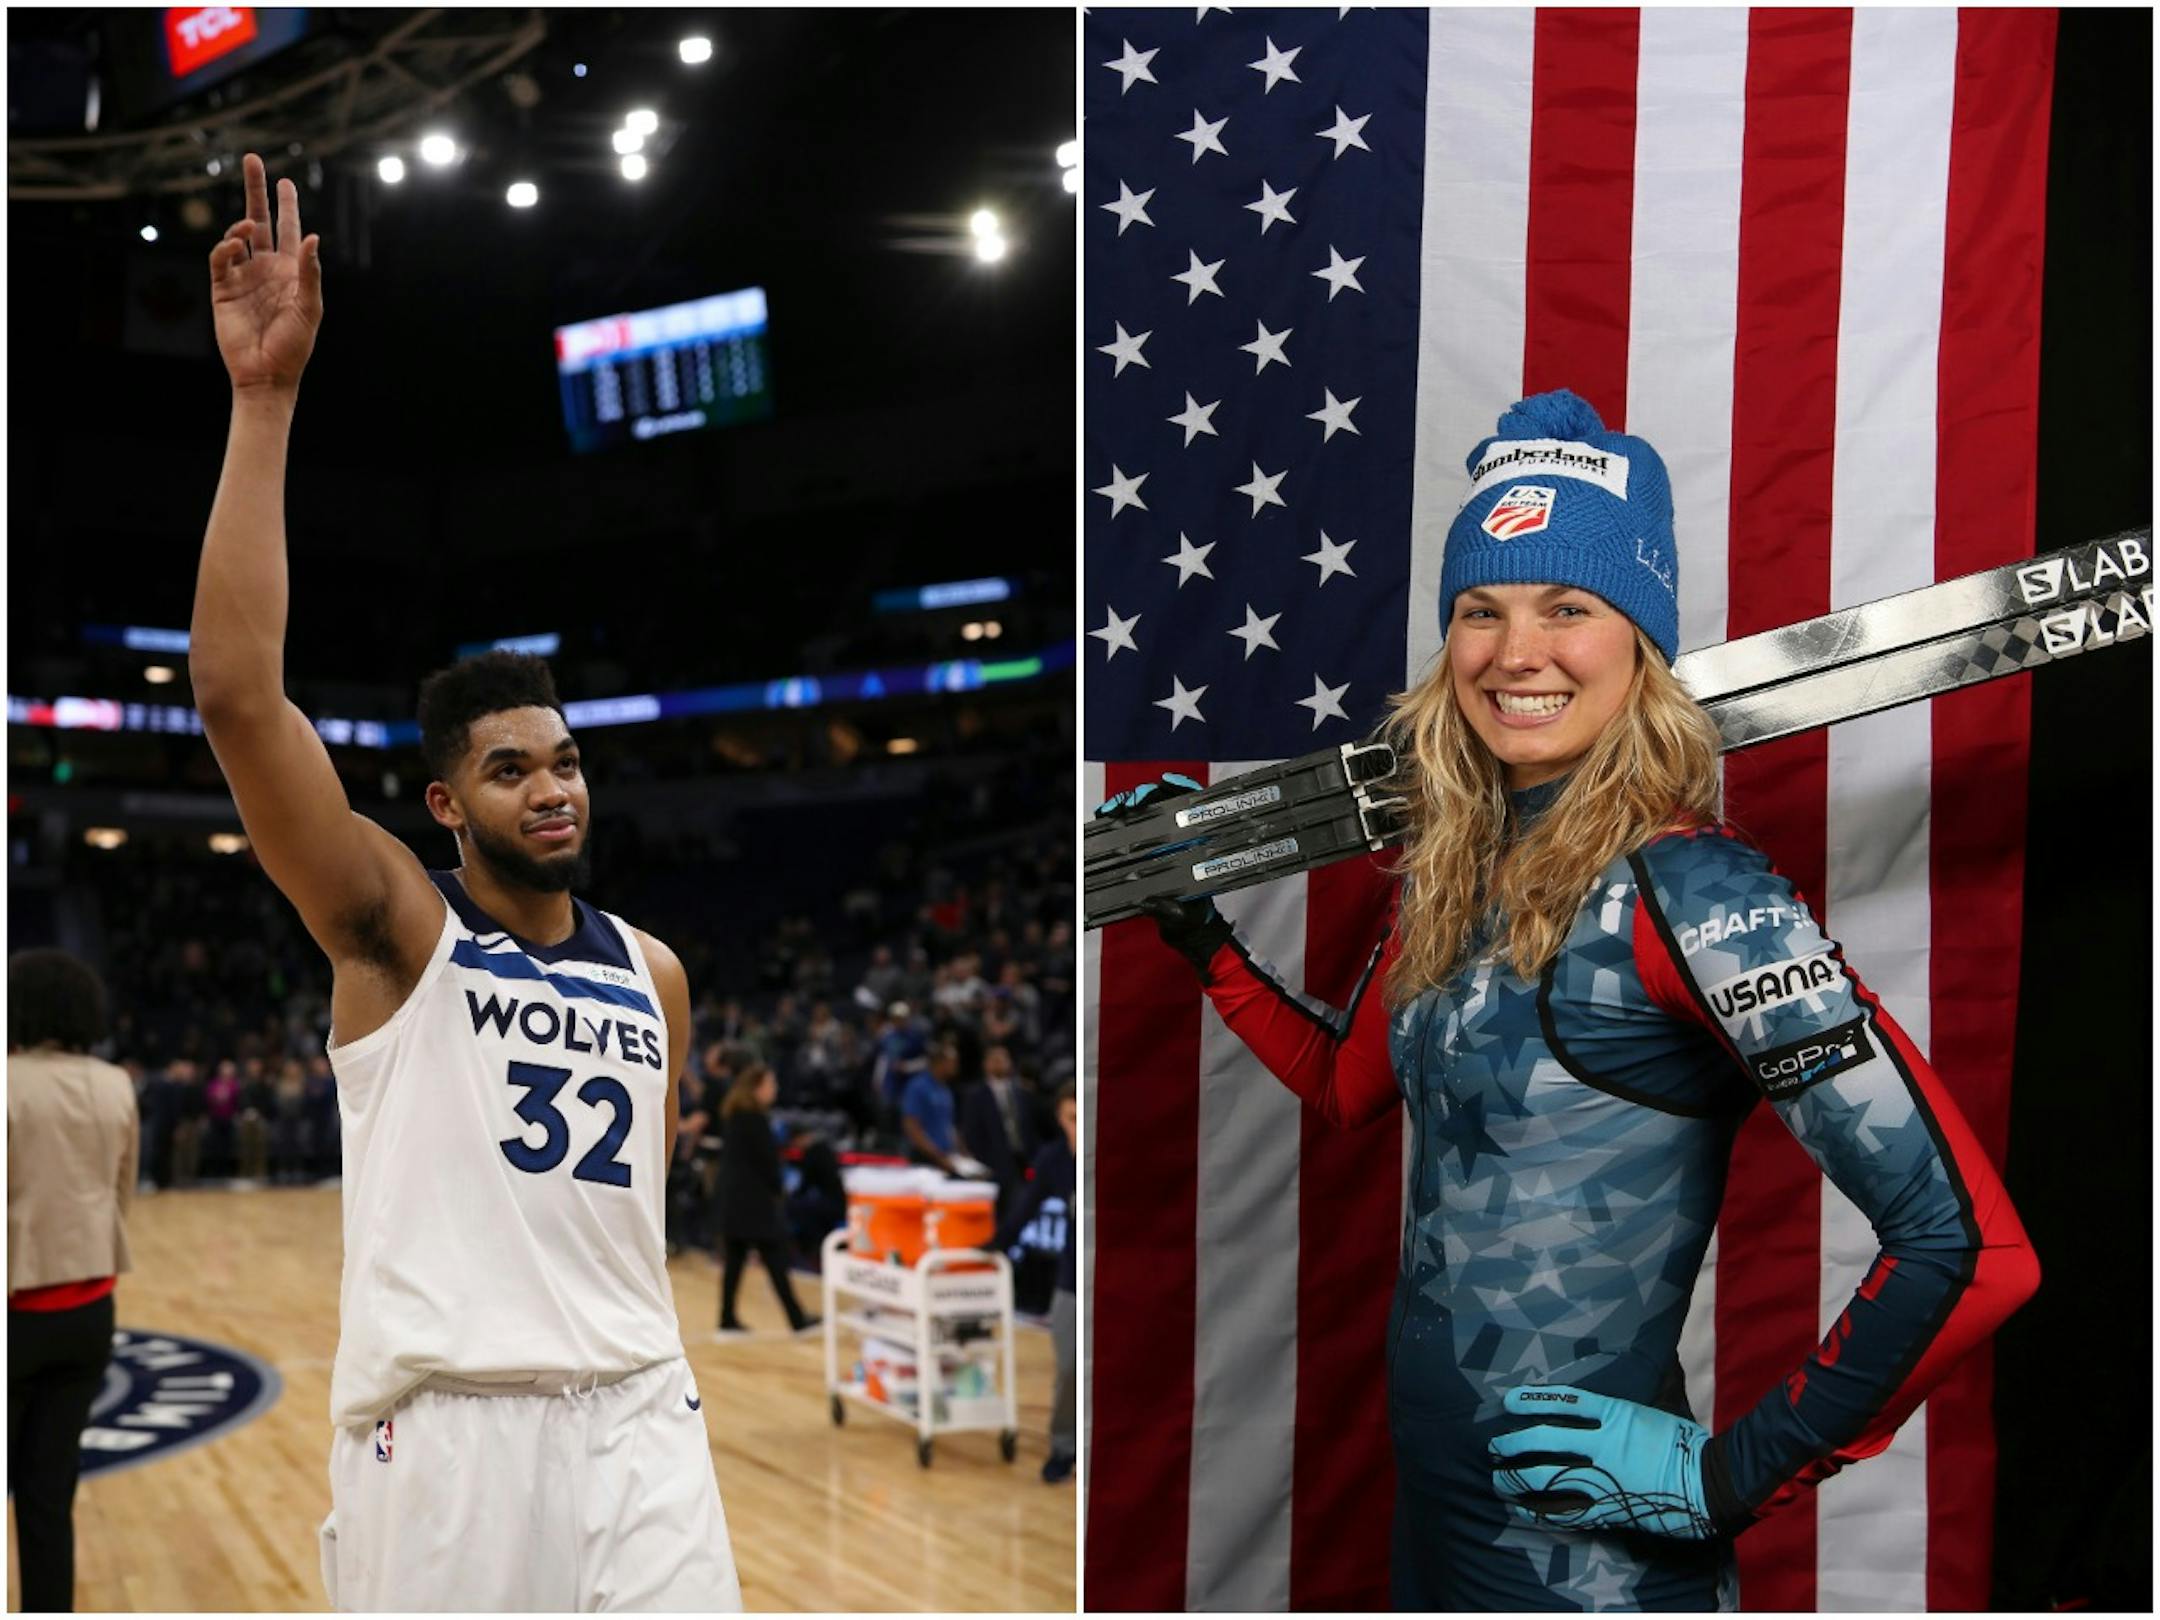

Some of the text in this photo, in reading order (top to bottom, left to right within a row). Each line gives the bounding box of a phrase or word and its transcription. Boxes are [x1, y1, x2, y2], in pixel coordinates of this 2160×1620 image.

[176, 7, 243, 48] TCL
[1680, 907, 1785, 957] CRAFT
[1711, 960, 1833, 1017] USANA
[465, 989, 662, 1070] WOLVES
[500, 1060, 633, 1188] 32
